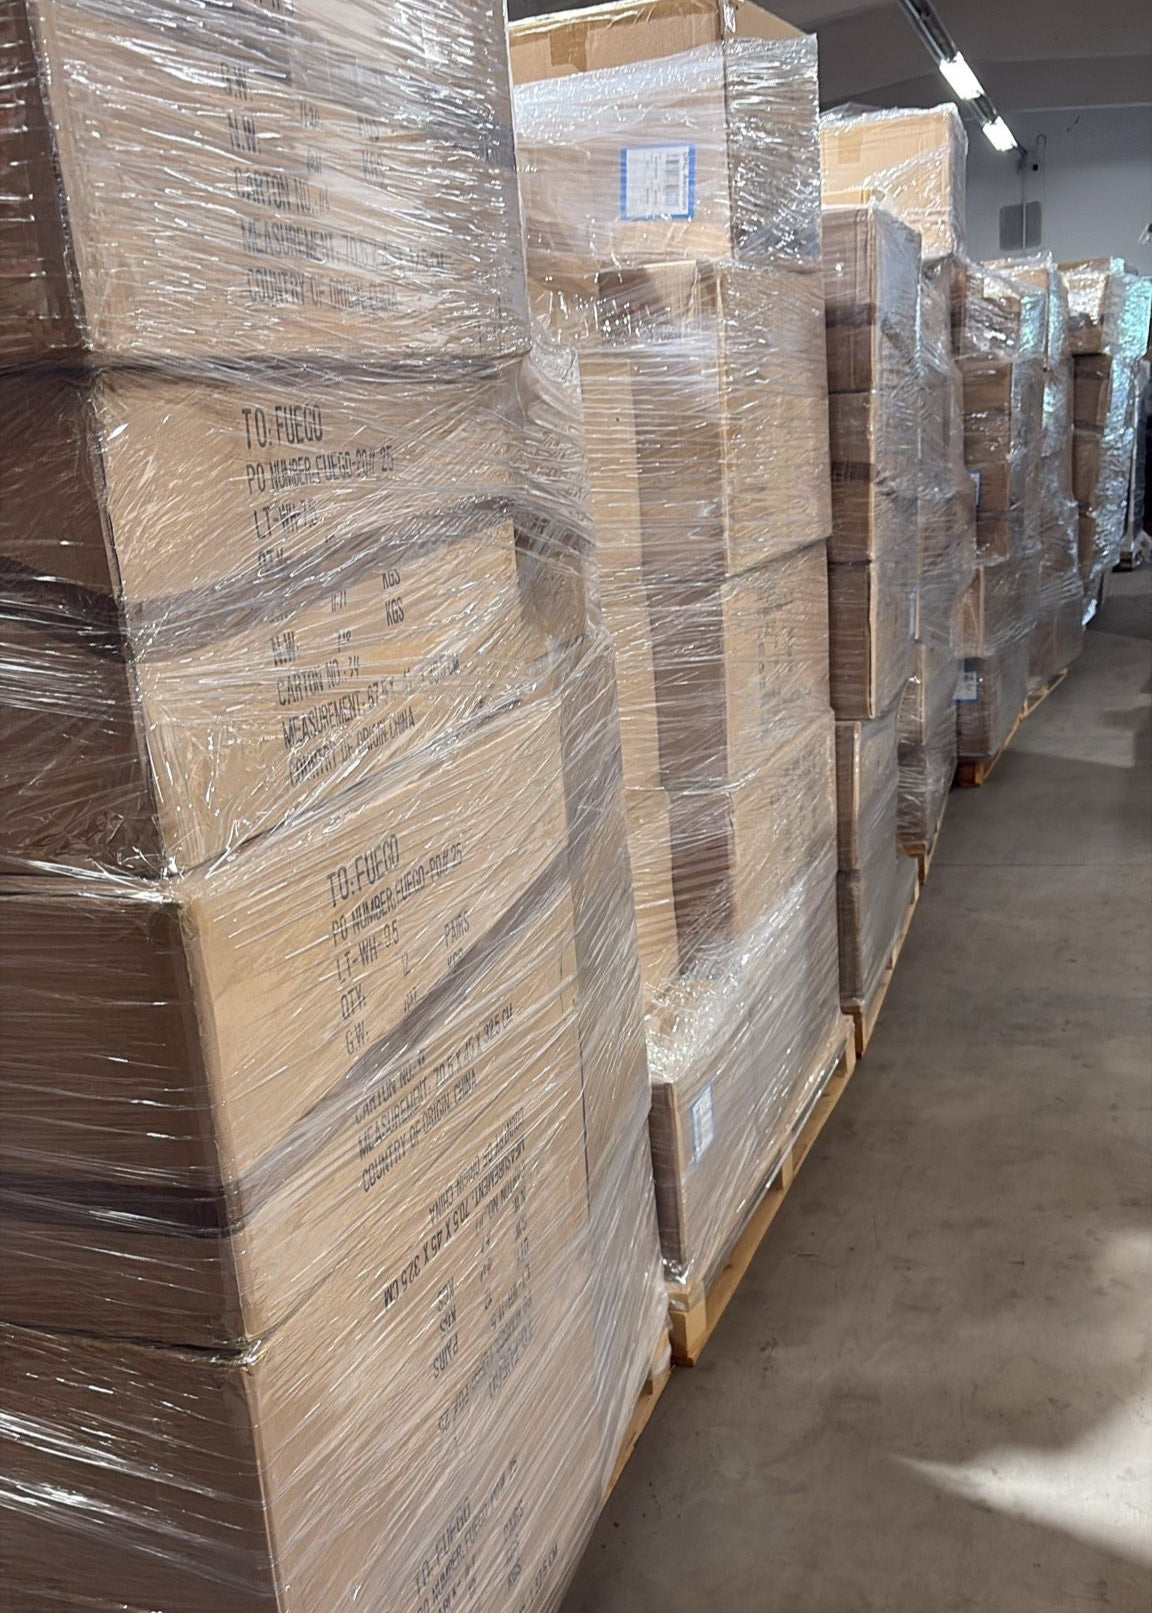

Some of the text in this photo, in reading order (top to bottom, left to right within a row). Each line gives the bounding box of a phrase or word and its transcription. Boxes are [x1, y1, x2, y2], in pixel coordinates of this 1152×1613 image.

[246, 463, 266, 495] PO
[385, 596, 405, 628] KGS
[332, 914, 347, 947] PO
[451, 842, 463, 869] 25
[444, 910, 470, 948] PAIRS
[361, 1130, 406, 1192] COUNTRY
[431, 1228, 444, 1257] 45
[384, 1275, 399, 1309] CM
[433, 1332, 459, 1378] PAIRS
